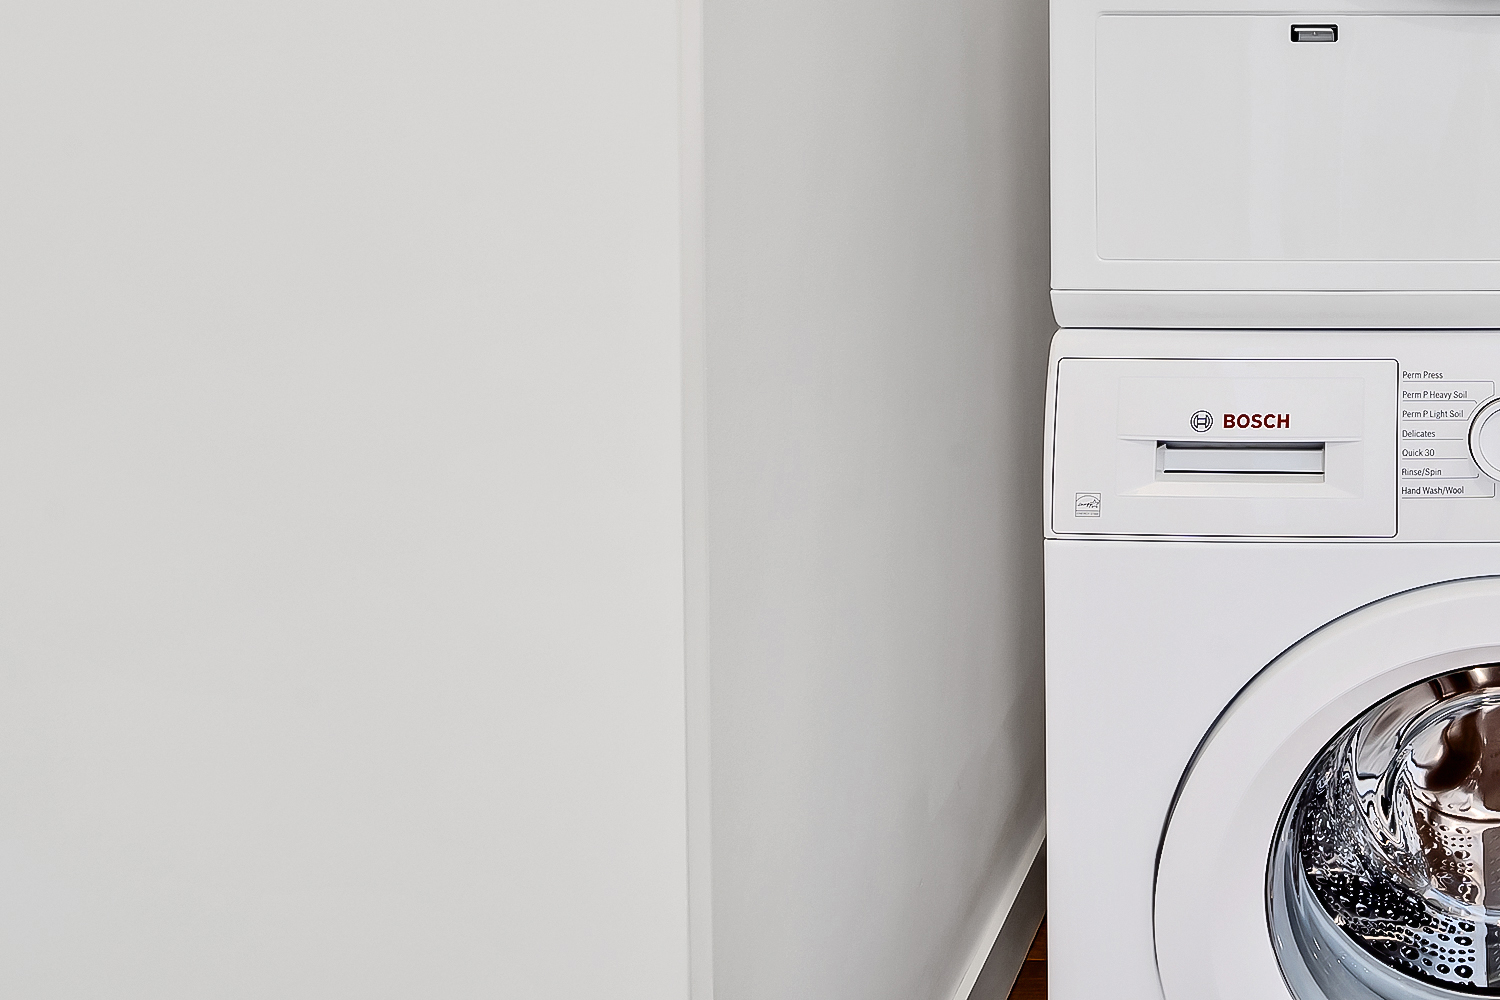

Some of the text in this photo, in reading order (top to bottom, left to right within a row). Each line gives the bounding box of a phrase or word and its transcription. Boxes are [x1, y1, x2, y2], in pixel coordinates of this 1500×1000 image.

[1402, 370, 1444, 379] Perm Press
[1402, 391, 1468, 400] Perm P Heavy Soil
[1402, 410, 1464, 419] Perm P Light Soil
[1223, 413, 1290, 429] BOSCH
[1402, 429, 1436, 438] Delicates
[1402, 448, 1435, 457] Quick 30
[1401, 468, 1442, 477] Rinse/Spin
[1401, 485, 1465, 495] Hand Wash/Wool
